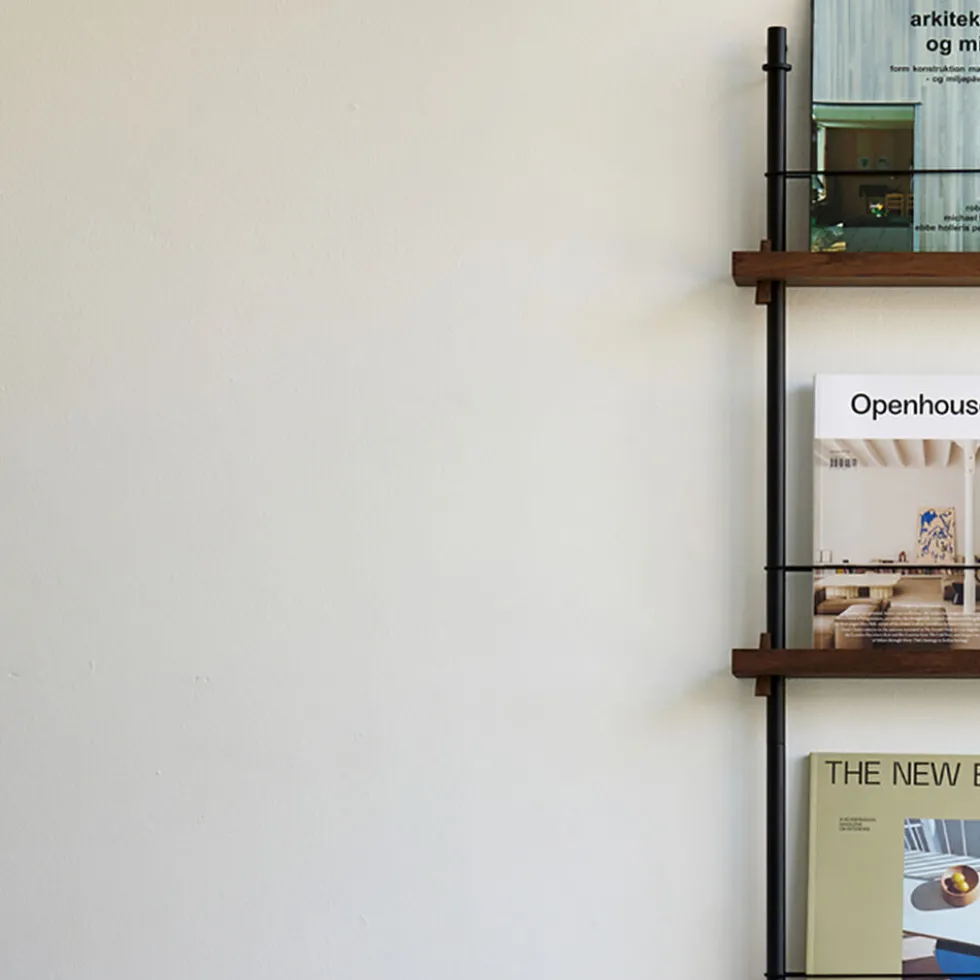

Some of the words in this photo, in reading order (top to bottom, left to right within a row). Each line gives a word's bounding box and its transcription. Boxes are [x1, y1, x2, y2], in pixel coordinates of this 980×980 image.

[926, 38, 952, 55] og
[932, 76, 944, 84] og
[825, 761, 880, 785] THE
[892, 762, 960, 786] NEW
